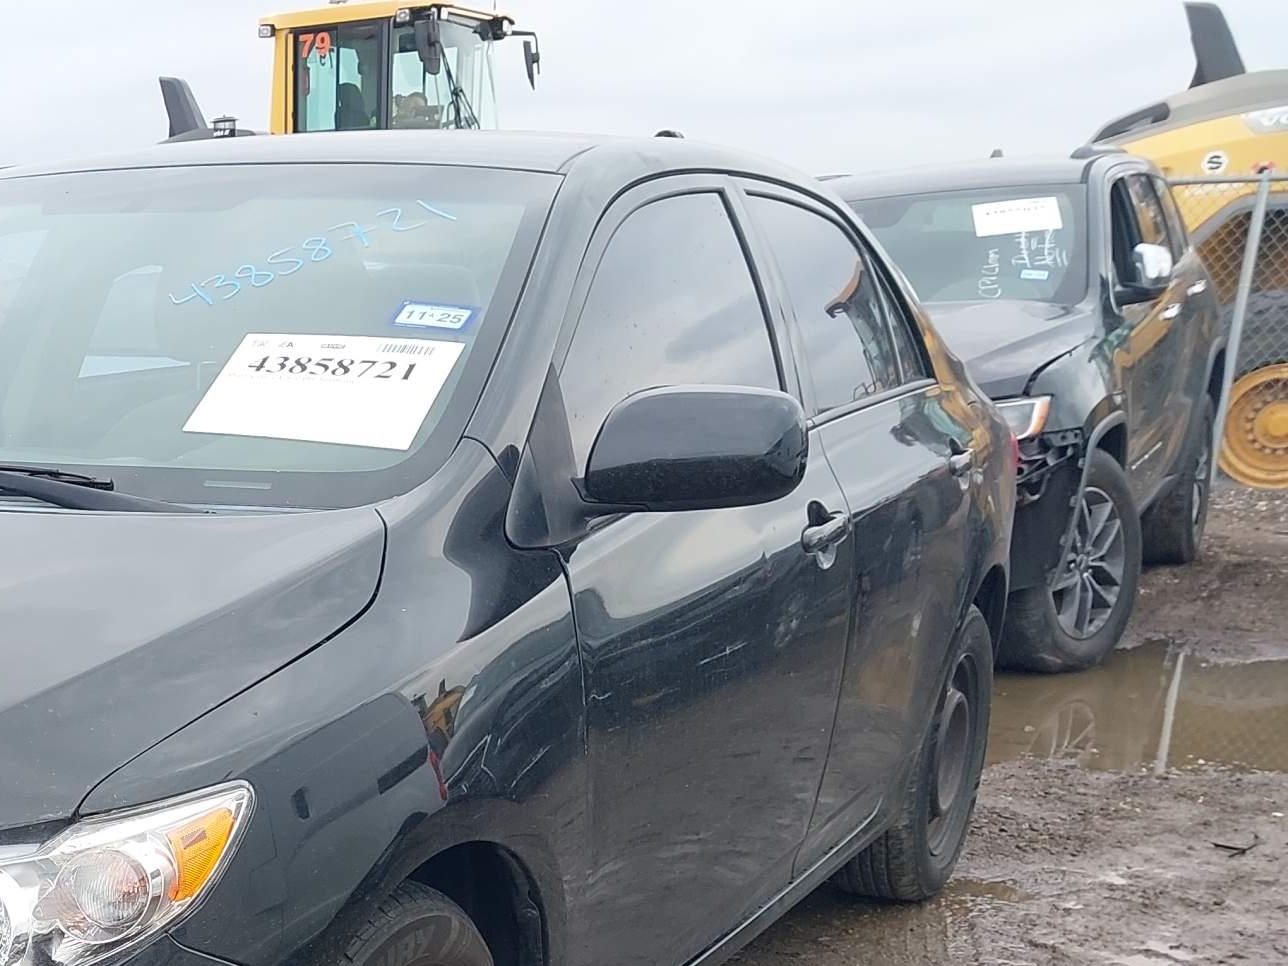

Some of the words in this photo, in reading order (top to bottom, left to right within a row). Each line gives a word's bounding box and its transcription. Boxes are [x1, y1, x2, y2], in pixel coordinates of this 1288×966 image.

[299, 32, 331, 58] 79
[169, 199, 457, 305] 43858721
[247, 354, 418, 381] 43858721
